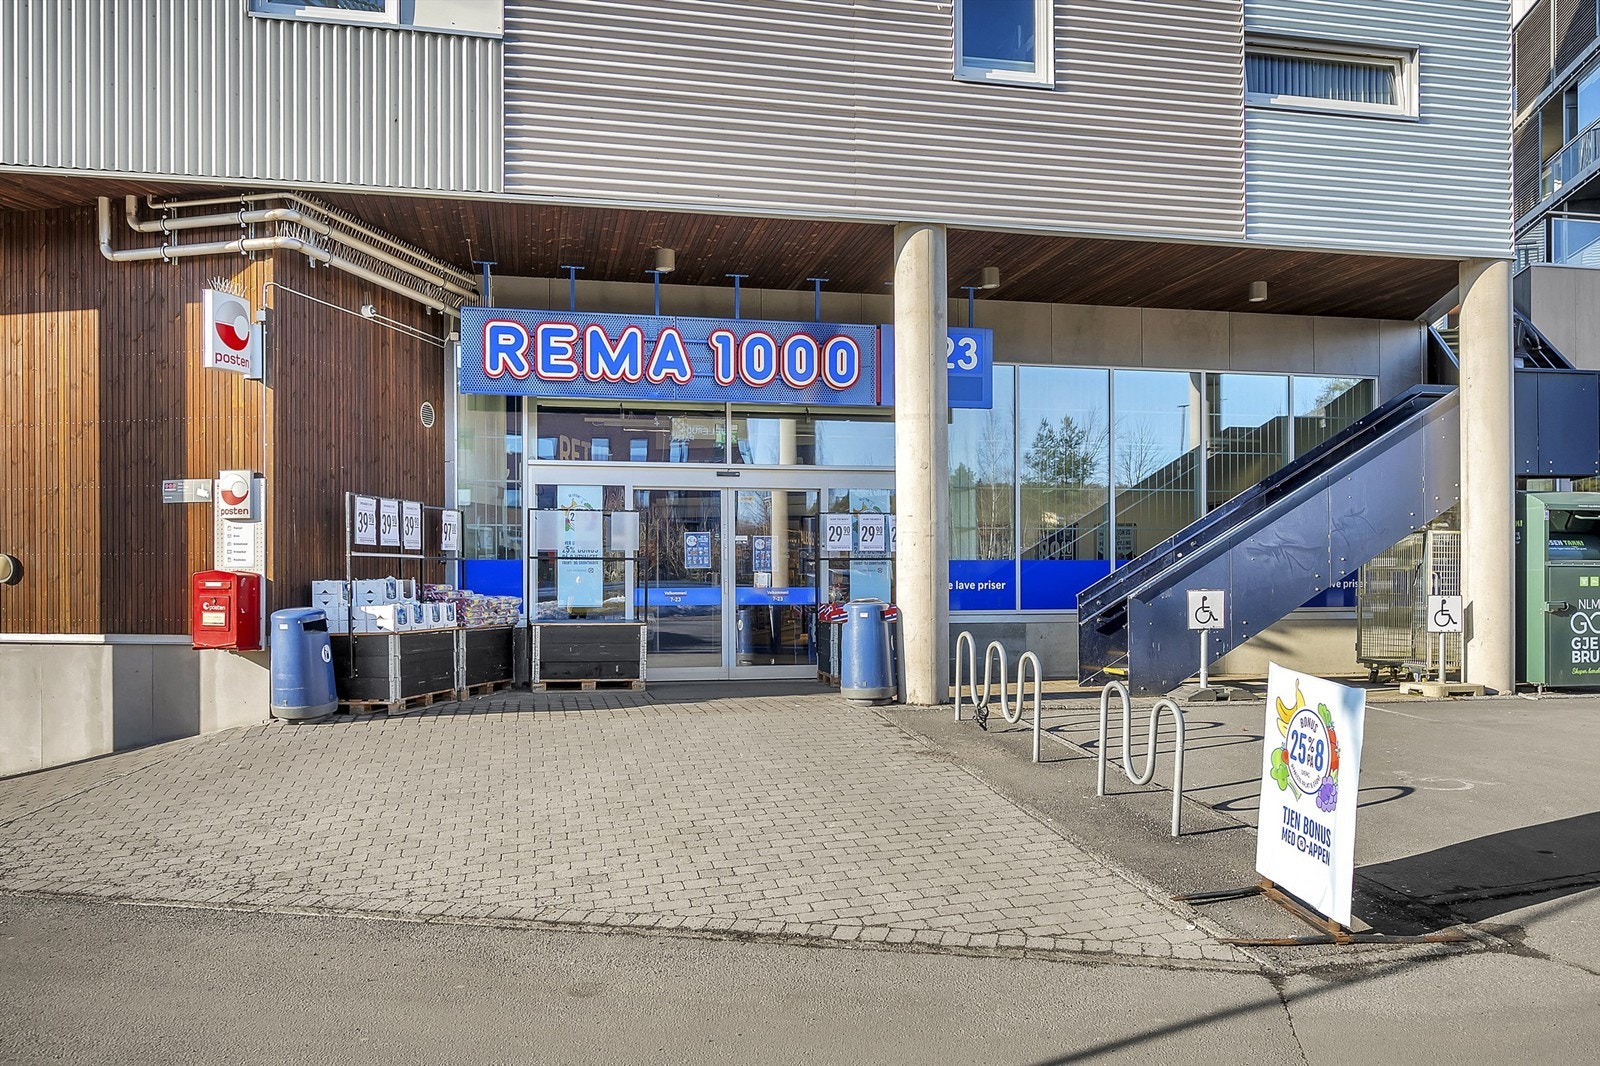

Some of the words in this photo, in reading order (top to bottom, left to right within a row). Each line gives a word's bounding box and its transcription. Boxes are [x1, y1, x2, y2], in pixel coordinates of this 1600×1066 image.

[215, 352, 249, 368] posten
[482, 319, 693, 385] REMA
[708, 329, 861, 390] 1000
[221, 507, 249, 516] posten
[358, 512, 368, 533] 39
[382, 514, 391, 534] 39
[405, 516, 414, 535] 39
[444, 523, 451, 541] 97
[828, 525, 842, 542] 29
[843, 526, 851, 534] 90
[861, 525, 875, 542] 29
[876, 526, 883, 534] 90
[956, 580, 975, 590] lave
[978, 580, 1006, 591] priser
[1578, 598, 1600, 610] NLM
[1571, 636, 1599, 650] GJE
[1571, 650, 1600, 664] BRU
[1300, 716, 1318, 733] BONUS
[1290, 729, 1307, 764] 25
[1315, 739, 1325, 771] 8
[1283, 805, 1301, 831] TJEN
[1303, 816, 1331, 848] BONUS
[1281, 827, 1296, 846] MED
